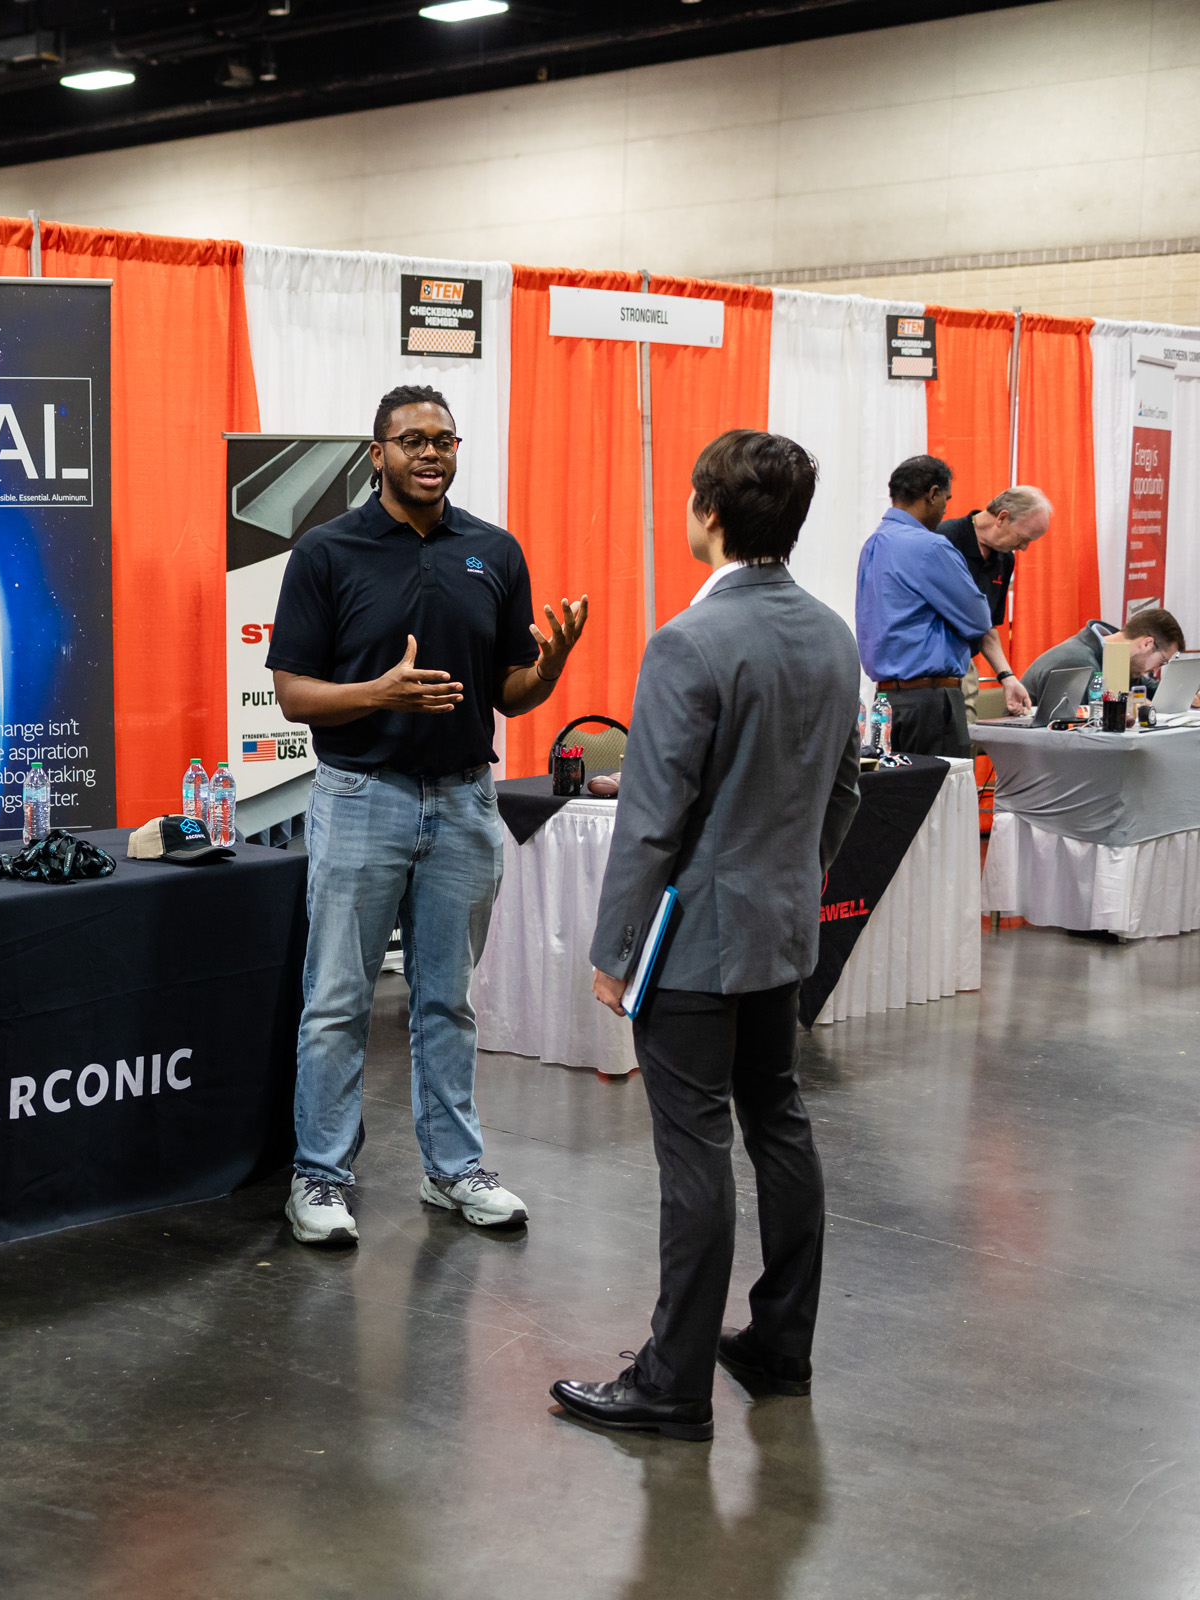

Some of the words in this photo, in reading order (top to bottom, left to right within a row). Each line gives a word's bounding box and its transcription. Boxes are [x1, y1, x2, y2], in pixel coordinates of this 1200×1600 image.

[434, 283, 463, 299] TEN
[409, 305, 474, 319] CHECKERBOARD
[620, 306, 669, 325] STRONGWELL
[425, 316, 459, 328] MEMBER
[906, 321, 923, 333] TEN
[19, 493, 51, 502] Essential.
[52, 493, 88, 502] Aluminum.
[242, 691, 278, 706] PULT
[49, 718, 80, 736] isn’t
[277, 738, 291, 746] MADE
[298, 737, 308, 745] THE
[8, 742, 89, 765] aspiration
[277, 745, 308, 760] USA
[48, 765, 96, 787] taking
